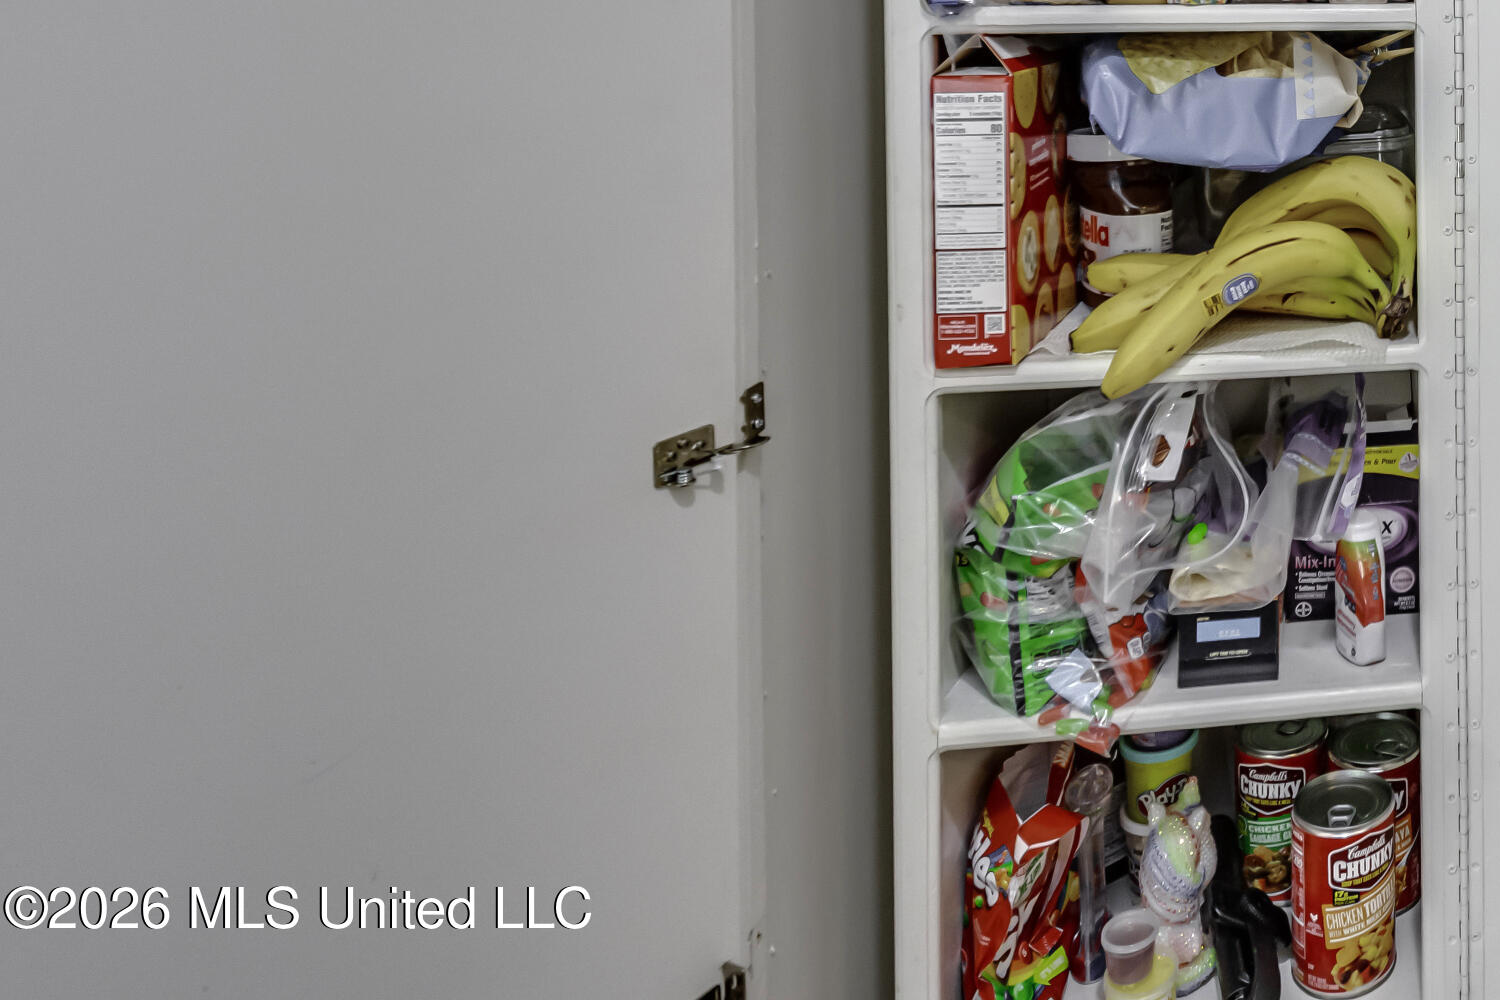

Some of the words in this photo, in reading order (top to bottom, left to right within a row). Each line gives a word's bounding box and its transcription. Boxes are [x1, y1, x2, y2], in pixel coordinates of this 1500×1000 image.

[936, 95, 975, 104] Nutrition
[977, 94, 1002, 103] Facts
[1381, 457, 1397, 466] Pour
[1248, 768, 1288, 783] Campbell's
[1240, 774, 1302, 800] CHUNKY
[1347, 833, 1386, 860] Campbell's
[1332, 838, 1395, 882] CHUNKY
[1325, 908, 1364, 930] CHICKEN
[1342, 923, 1366, 936] WHITE
